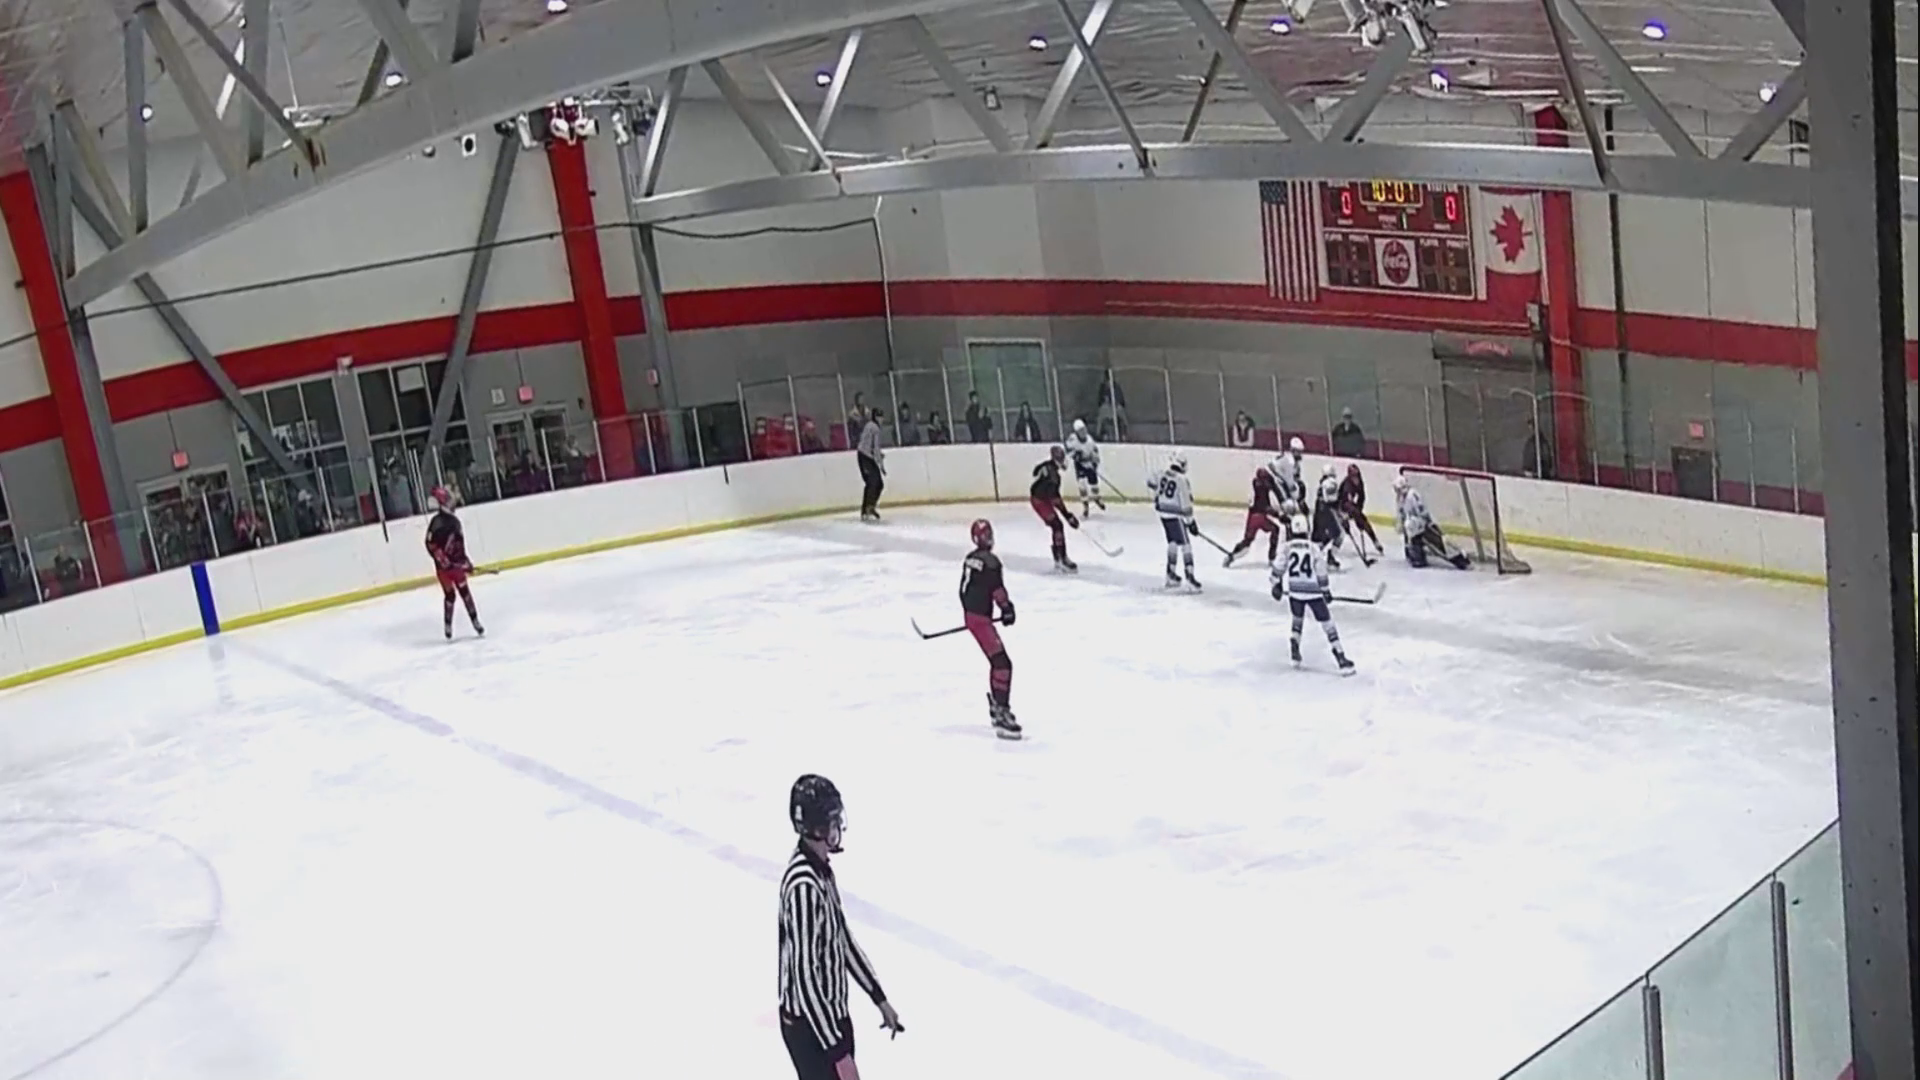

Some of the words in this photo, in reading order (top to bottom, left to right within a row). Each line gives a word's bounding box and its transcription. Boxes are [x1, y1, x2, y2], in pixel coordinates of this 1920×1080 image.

[1341, 191, 1352, 215] 0
[1445, 195, 1456, 220] 0
[1289, 552, 1312, 578] 24
